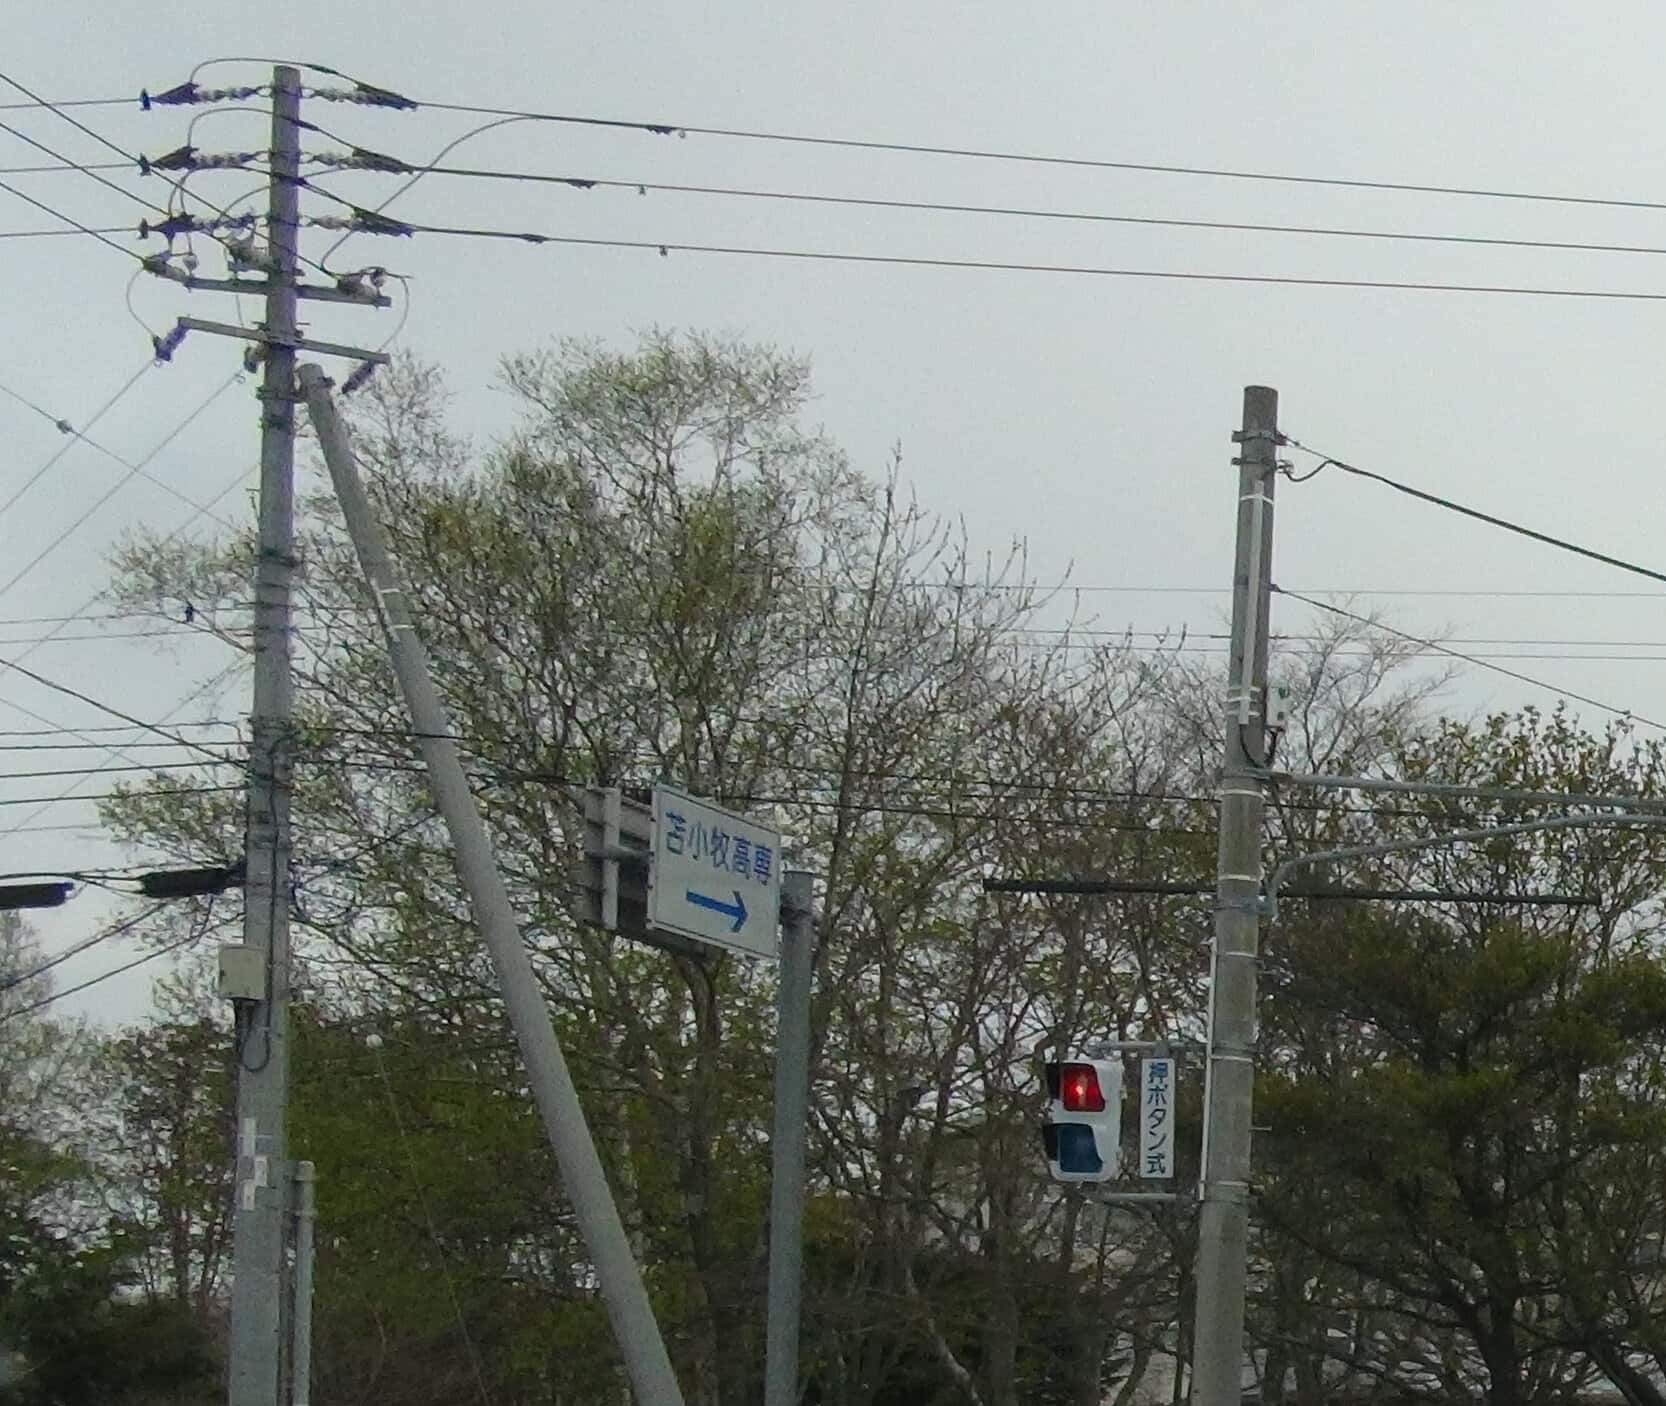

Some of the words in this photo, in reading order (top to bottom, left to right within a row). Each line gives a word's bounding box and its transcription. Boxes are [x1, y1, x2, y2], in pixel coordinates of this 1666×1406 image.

[664, 810, 774, 887] 苫小牧高専
[1147, 1062, 1169, 1174] 押ボタン式
